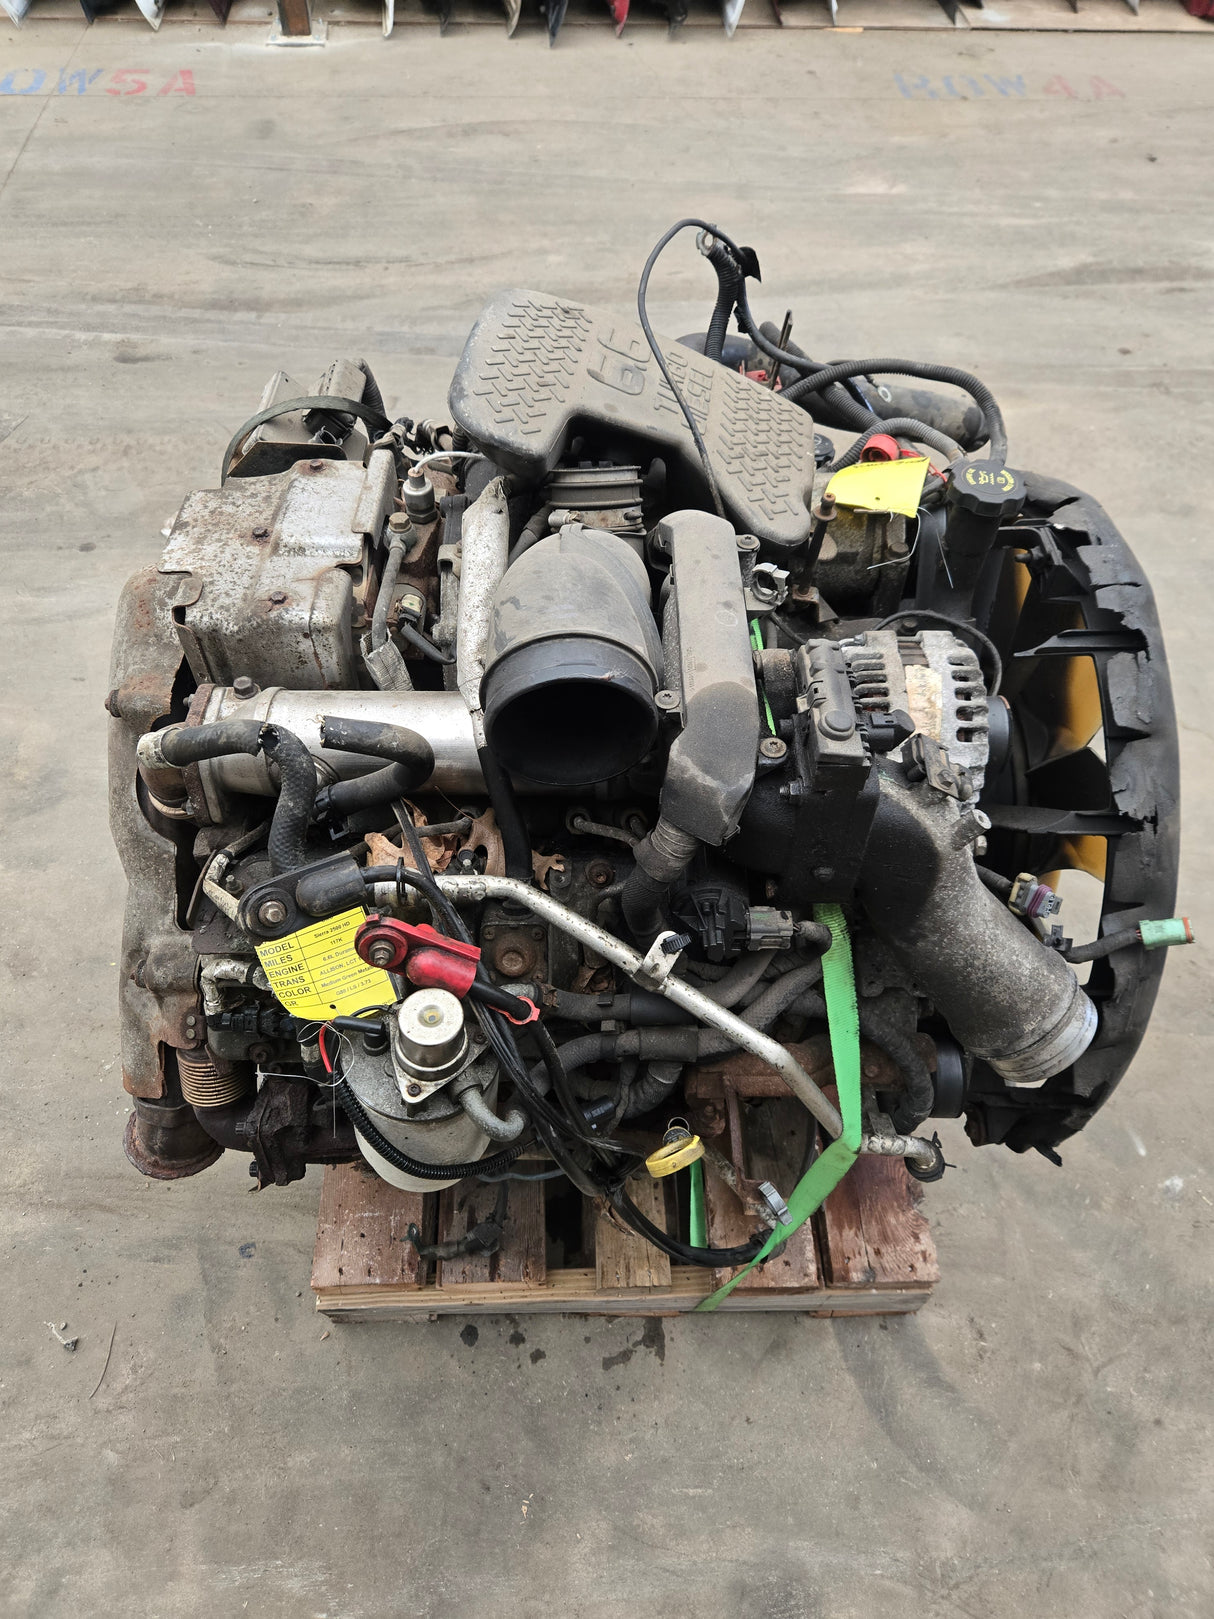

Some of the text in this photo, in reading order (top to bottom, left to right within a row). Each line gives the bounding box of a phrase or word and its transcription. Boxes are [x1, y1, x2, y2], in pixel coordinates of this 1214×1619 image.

[105, 68, 197, 96] 5A
[260, 942, 295, 957] MODEL
[314, 930, 330, 939] Sierra
[264, 954, 293, 968] MILES
[268, 963, 305, 979] ENGINE
[273, 976, 306, 989] TRANS
[278, 986, 311, 999] COLOR
[321, 978, 341, 988] Medium
[342, 972, 358, 980] Green
